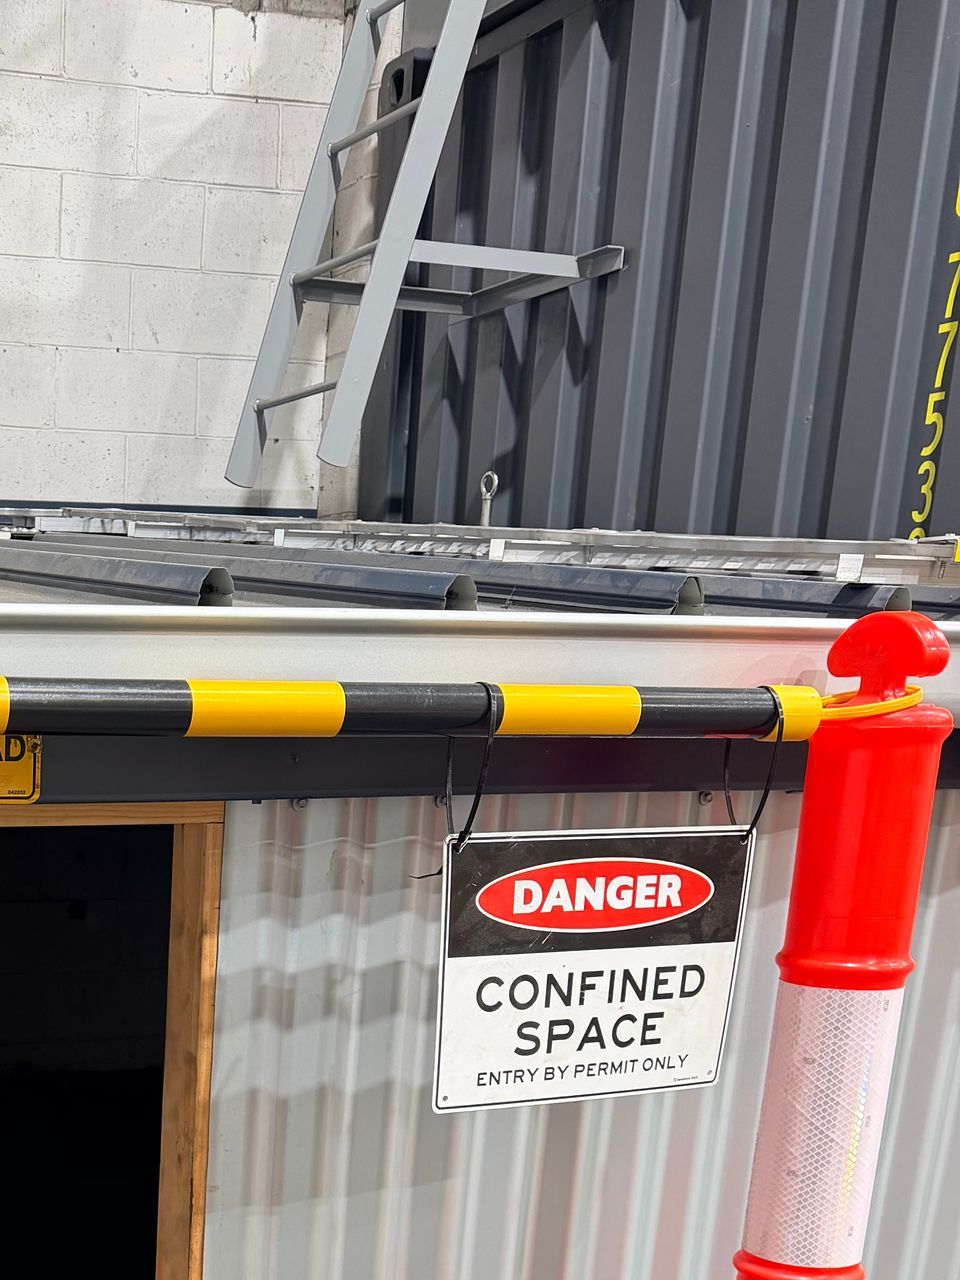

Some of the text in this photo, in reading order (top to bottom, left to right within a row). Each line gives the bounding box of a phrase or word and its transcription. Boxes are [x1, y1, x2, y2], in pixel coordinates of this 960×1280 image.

[512, 874, 682, 915] DANGER
[475, 964, 706, 1013] CONFINED
[513, 1011, 665, 1056] SPACE
[476, 1053, 689, 1087] ENTRY BY PERMIT ONLY
